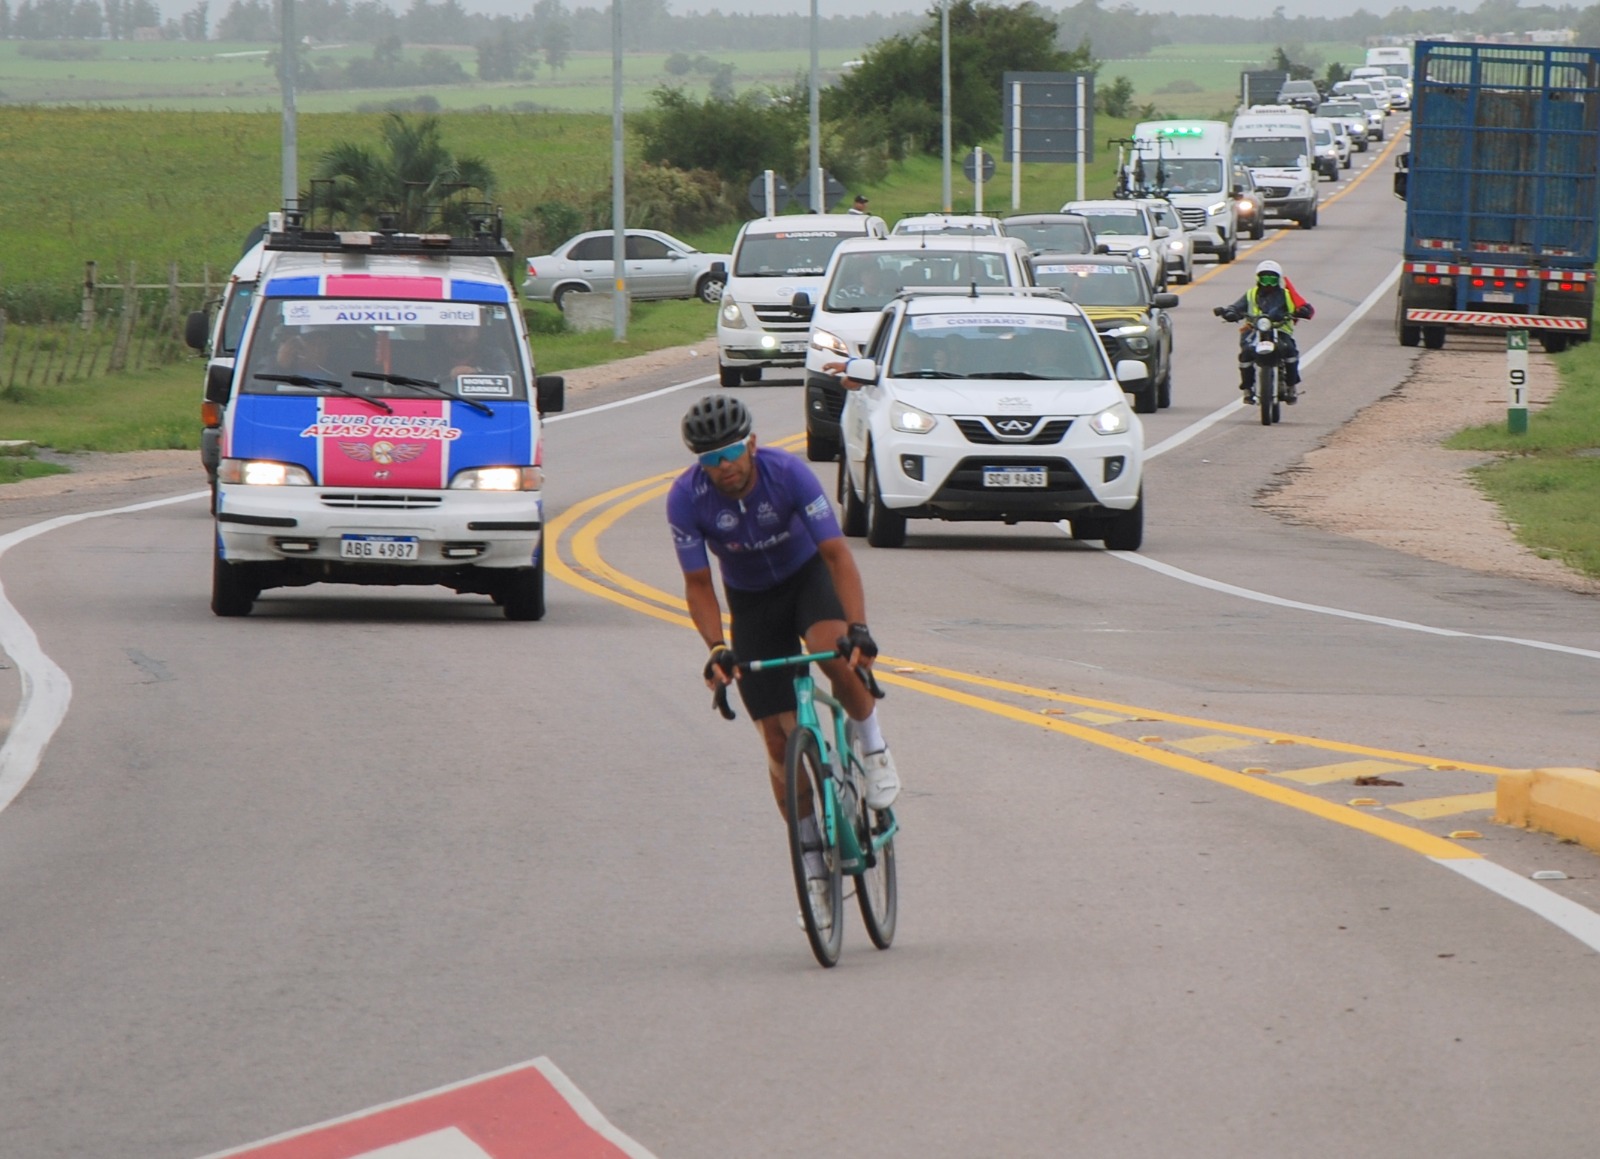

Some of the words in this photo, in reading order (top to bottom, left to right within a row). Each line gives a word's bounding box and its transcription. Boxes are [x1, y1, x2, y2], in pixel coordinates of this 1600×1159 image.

[336, 311, 418, 321] AUXILIO
[439, 310, 475, 320] antel
[946, 317, 1027, 326] COMISARIO
[1510, 335, 1525, 347] K
[319, 416, 365, 425] CLUB
[371, 416, 448, 427] CICLISTA
[302, 425, 369, 436] ALAS
[376, 426, 461, 439] ROJAS
[345, 541, 373, 556] ABG
[378, 543, 414, 558] 4987
